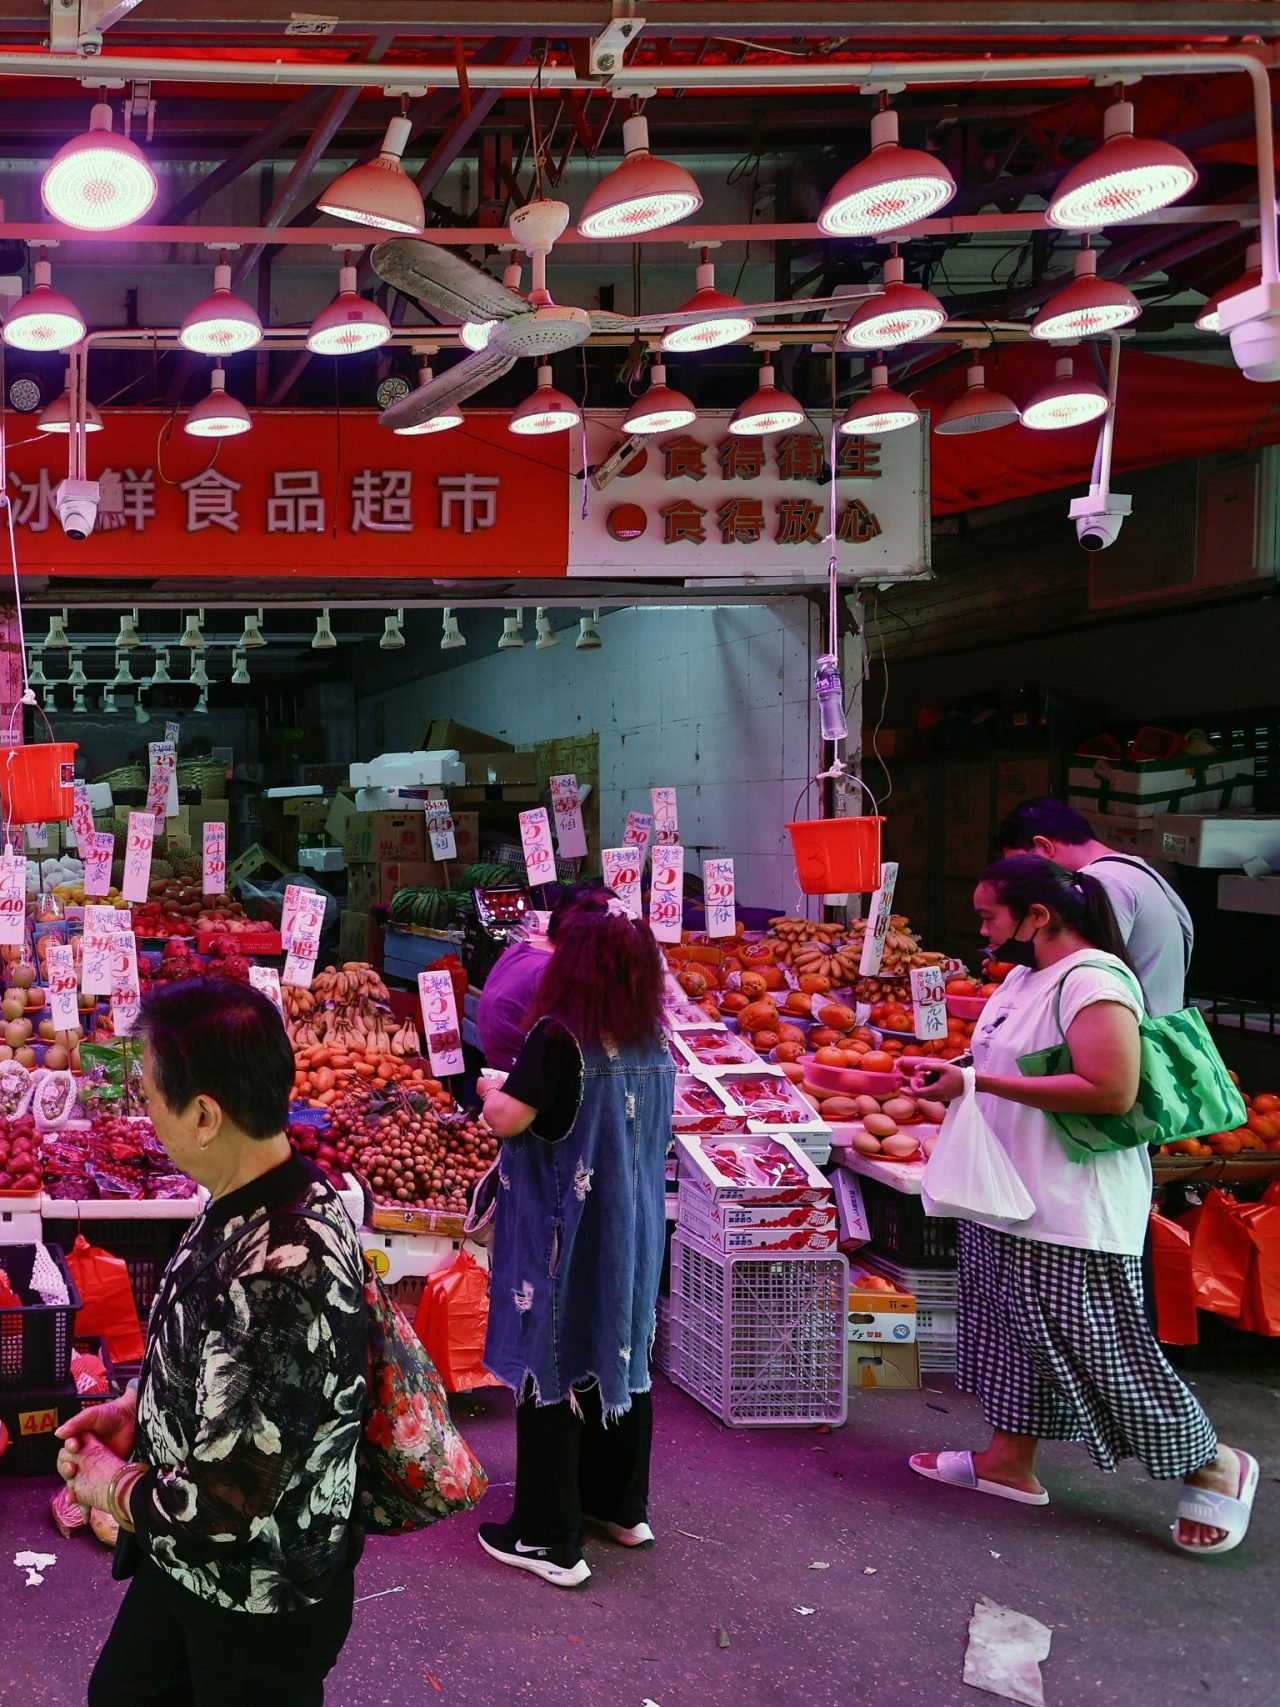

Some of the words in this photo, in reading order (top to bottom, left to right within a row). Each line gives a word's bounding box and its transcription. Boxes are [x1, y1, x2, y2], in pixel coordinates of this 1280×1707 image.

[659, 434, 882, 481] 食得衛生
[659, 498, 882, 545] 食得放心
[149, 783, 169, 797] 30
[152, 802, 164, 816] 5
[656, 806, 674, 821] 4
[427, 818, 452, 832] 45
[129, 836, 152, 851] 20
[524, 825, 543, 846] 2
[624, 830, 647, 843] 20
[656, 831, 679, 844] 25
[206, 842, 222, 855] 4
[526, 850, 549, 867] 40
[205, 861, 224, 876] 30
[610, 868, 638, 887] 70
[654, 868, 676, 892] 2
[708, 884, 733, 901] 20
[0, 899, 23, 912] 40
[652, 902, 676, 921] 30
[299, 913, 317, 935] 2
[714, 908, 731, 925] 份
[111, 956, 130, 978] 2
[51, 976, 77, 994] 50
[920, 986, 945, 1007] 20
[429, 997, 449, 1022] 2
[926, 1015, 943, 1033] 份
[24, 1412, 56, 1433] 4A
